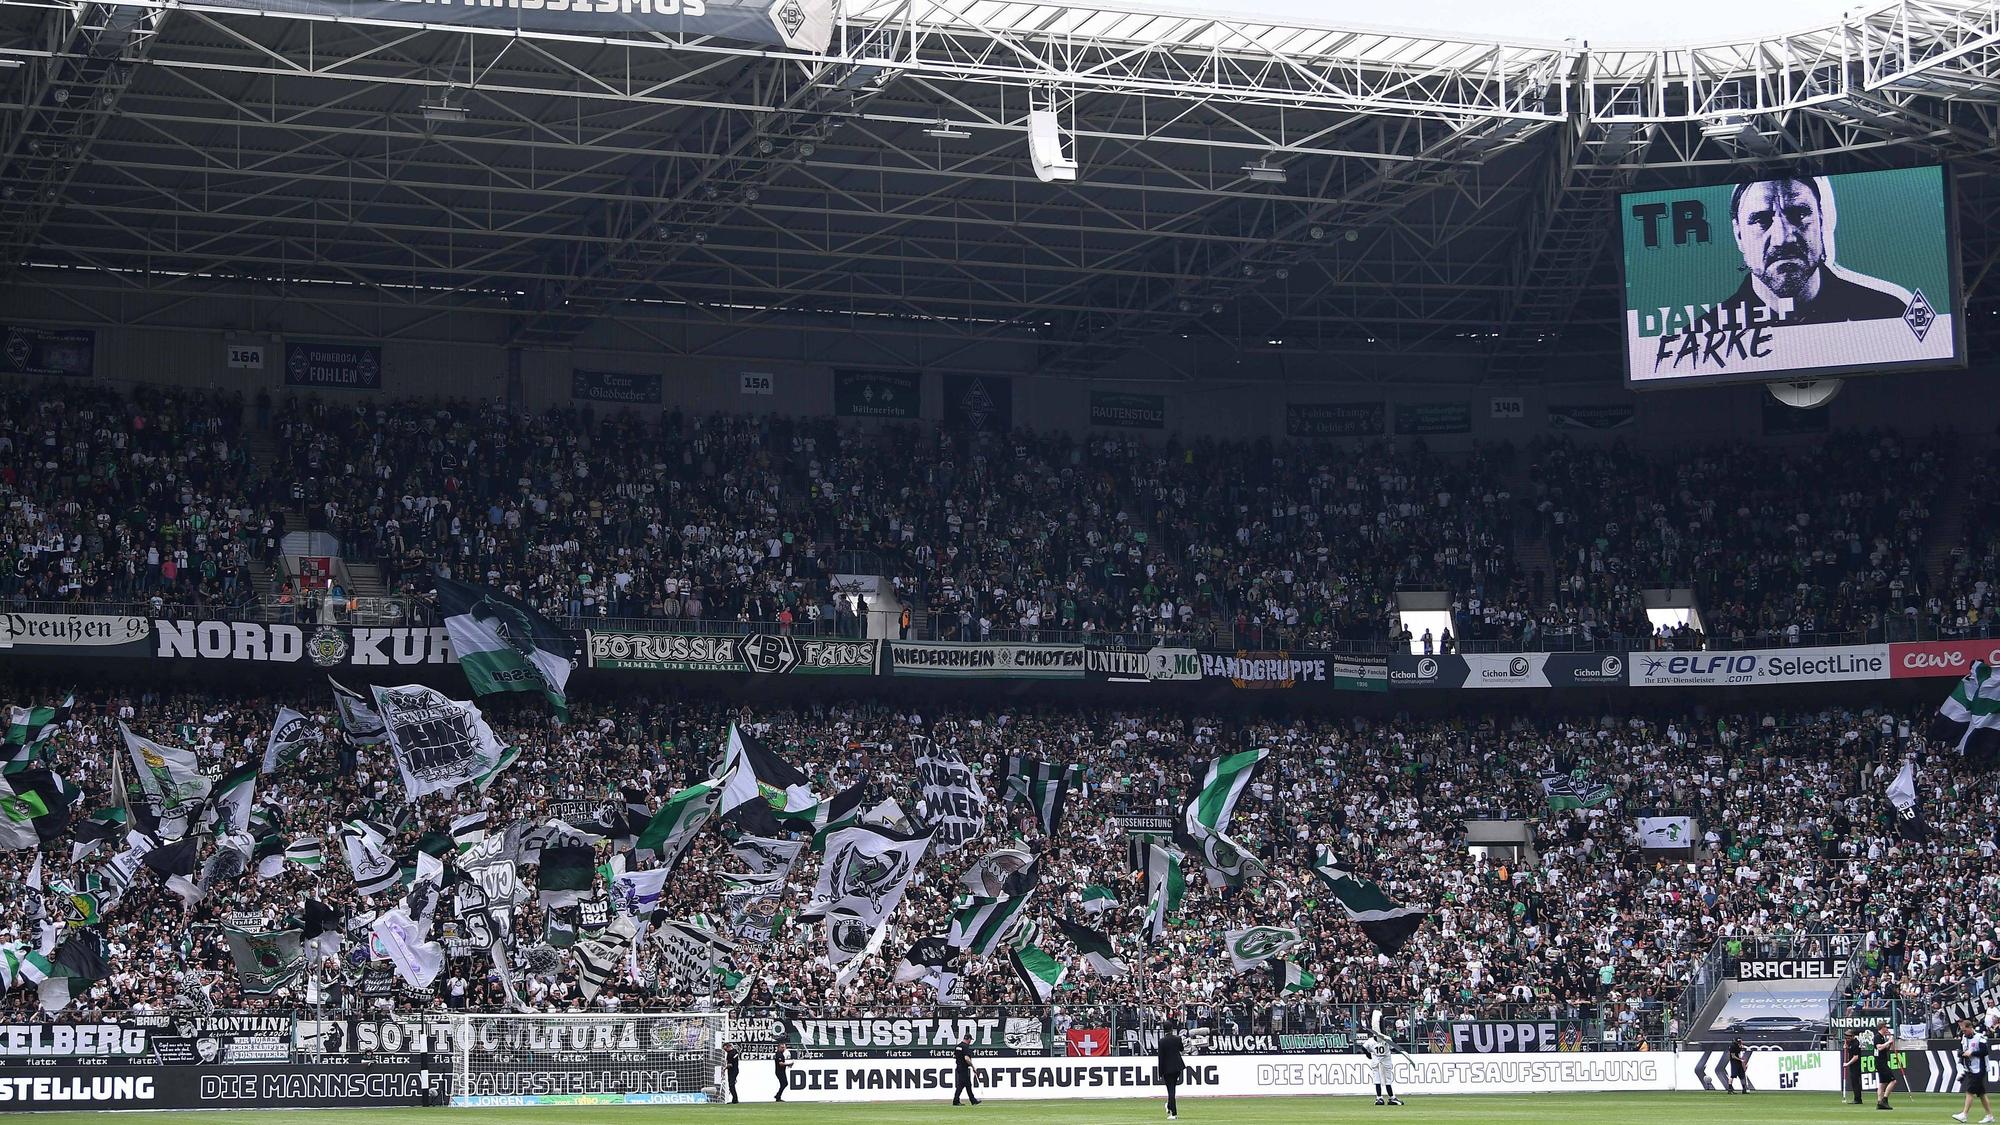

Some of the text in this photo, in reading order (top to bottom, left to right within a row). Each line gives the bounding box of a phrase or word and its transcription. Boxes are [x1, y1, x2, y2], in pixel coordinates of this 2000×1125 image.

[1632, 200, 1711, 250] TR
[231, 350, 260, 363] 16A
[310, 351, 358, 364] PONDEROSA
[1655, 327, 1773, 374] FARKE
[744, 377, 769, 389] 15A
[1092, 406, 1162, 421] RAUTENSTOLZ
[1495, 402, 1520, 413] 14A
[1, 614, 112, 643] Preußen
[155, 619, 461, 665] NORD KUR
[591, 634, 733, 663] BORUSSIA
[803, 641, 874, 668] FANS
[894, 646, 1083, 667] NIEDERRHEIN CHAOTEN
[617, 660, 656, 669] IMMER
[663, 662, 686, 670] UND
[1087, 649, 1198, 675] UNITED MG
[1768, 653, 1882, 676] SelectLine
[1903, 651, 1965, 669] cewe
[1200, 655, 1325, 681] RANDGRUPPE
[1390, 671, 1416, 679] Cichon
[1482, 670, 1508, 678] Cichon
[1574, 668, 1600, 677] Cichon
[1724, 673, 1753, 684] .com
[277, 720, 302, 743] LIEBE
[206, 765, 221, 775] VFL
[1116, 818, 1172, 828] RUSSENFESTUNG
[580, 901, 608, 914] 1900
[582, 913, 608, 925] 1921
[1740, 960, 1848, 979] BRACHELE
[195, 1016, 290, 1032] FRONTLINE
[728, 1017, 774, 1031] EGLEIT
[728, 1030, 771, 1043] ERVICE
[792, 1018, 999, 1047] VITUSSTADT
[1453, 1022, 1557, 1053] FUPPE
[1279, 1033, 1349, 1049] KINZIGTAL
[611, 1053, 647, 1061] flatex
[668, 1052, 704, 1061] flatex
[885, 1050, 912, 1058] flatex
[972, 1049, 999, 1057] flatex
[1374, 1045, 1385, 1055] 10
[312, 1055, 350, 1064] flatex
[1778, 1052, 1822, 1072] FOHLEN
[1861, 1052, 1906, 1073] FOEN
[789, 1065, 1219, 1091] DIE MANNSCAFTSAUFSTELLNG
[1257, 1060, 1657, 1086] DIE MANNCHAFTSAUFSTELLUNG
[1779, 1072, 1799, 1089] ELF
[201, 1076, 257, 1100] DIE
[476, 1095, 524, 1106] JONGEN
[649, 1094, 694, 1105] JONGEN
